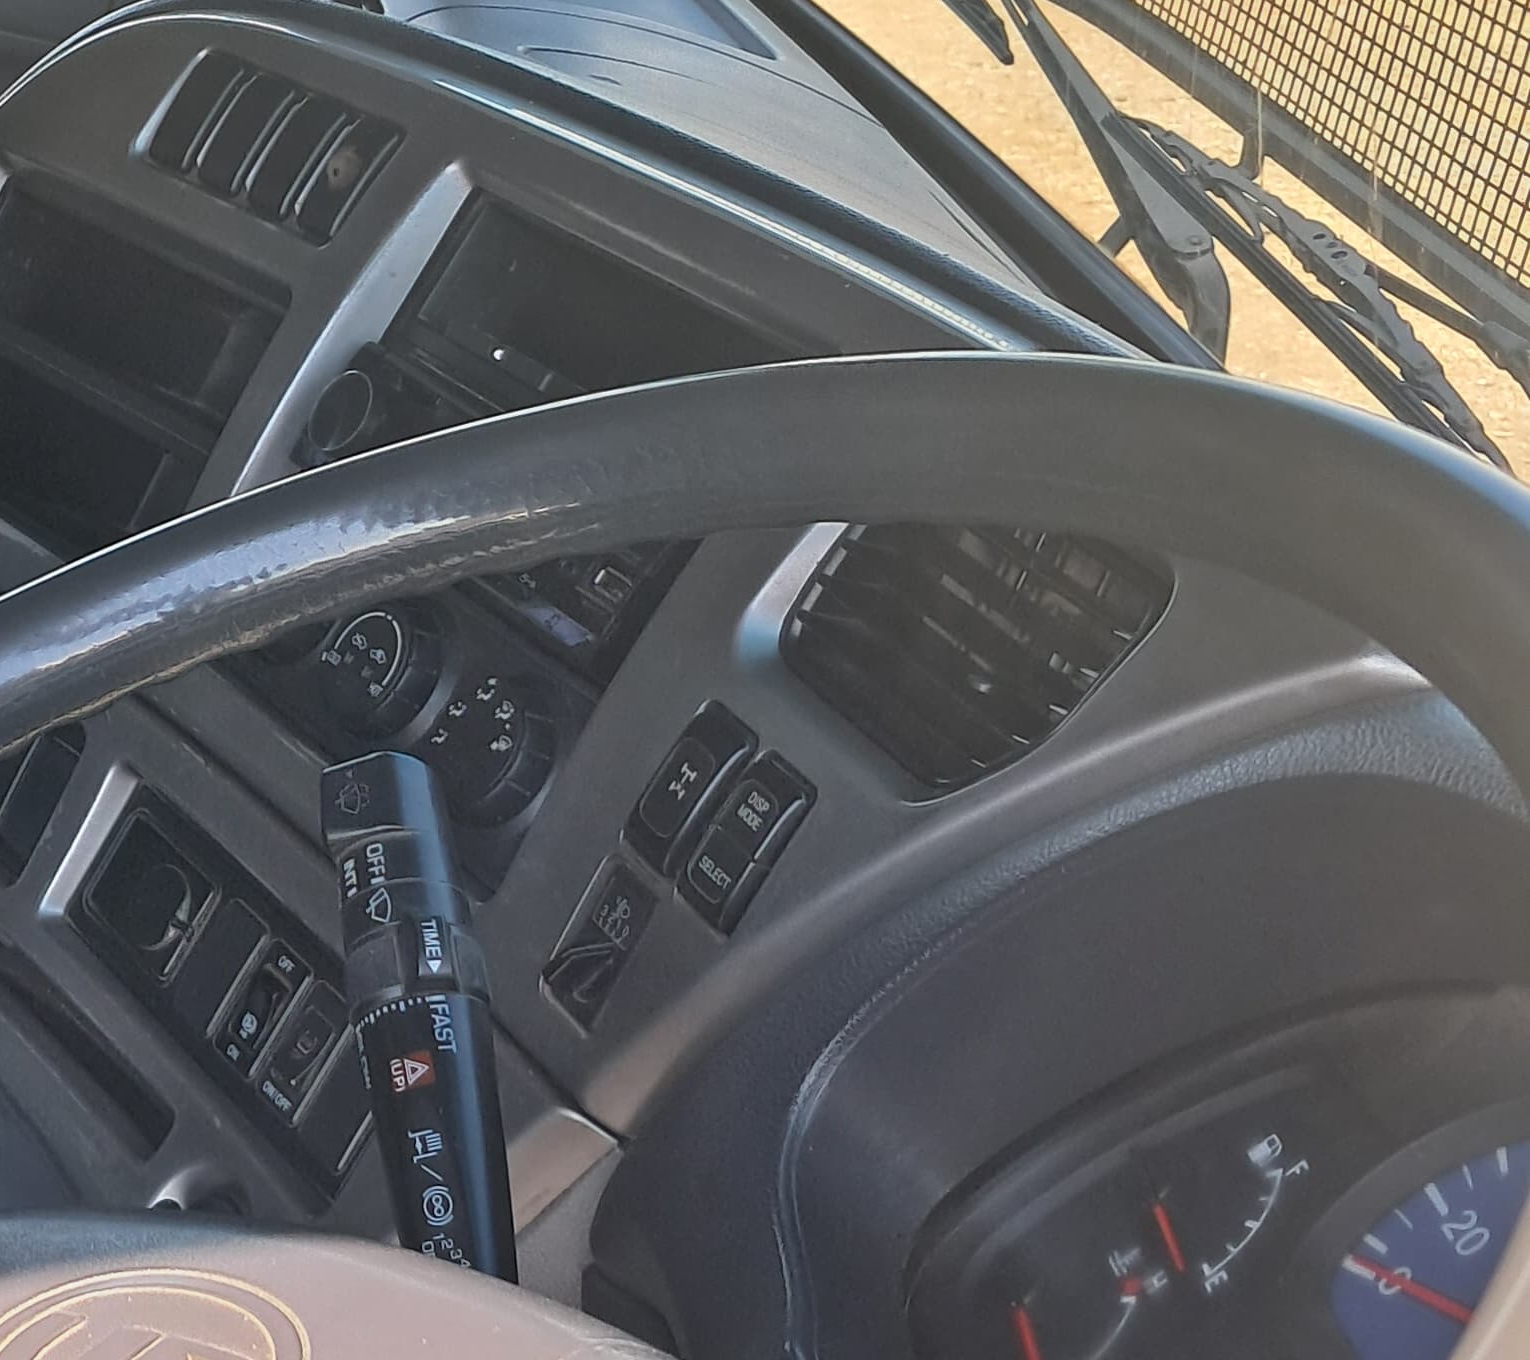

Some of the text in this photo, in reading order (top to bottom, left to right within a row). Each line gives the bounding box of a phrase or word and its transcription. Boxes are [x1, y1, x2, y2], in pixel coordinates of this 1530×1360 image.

[736, 805, 764, 831] MODE
[747, 791, 770, 813] DISP
[366, 843, 386, 878] OFF
[698, 855, 732, 889] SELECT
[420, 919, 443, 960] TIME
[429, 1003, 458, 1055] FAST
[1441, 1209, 1491, 1256] 20
